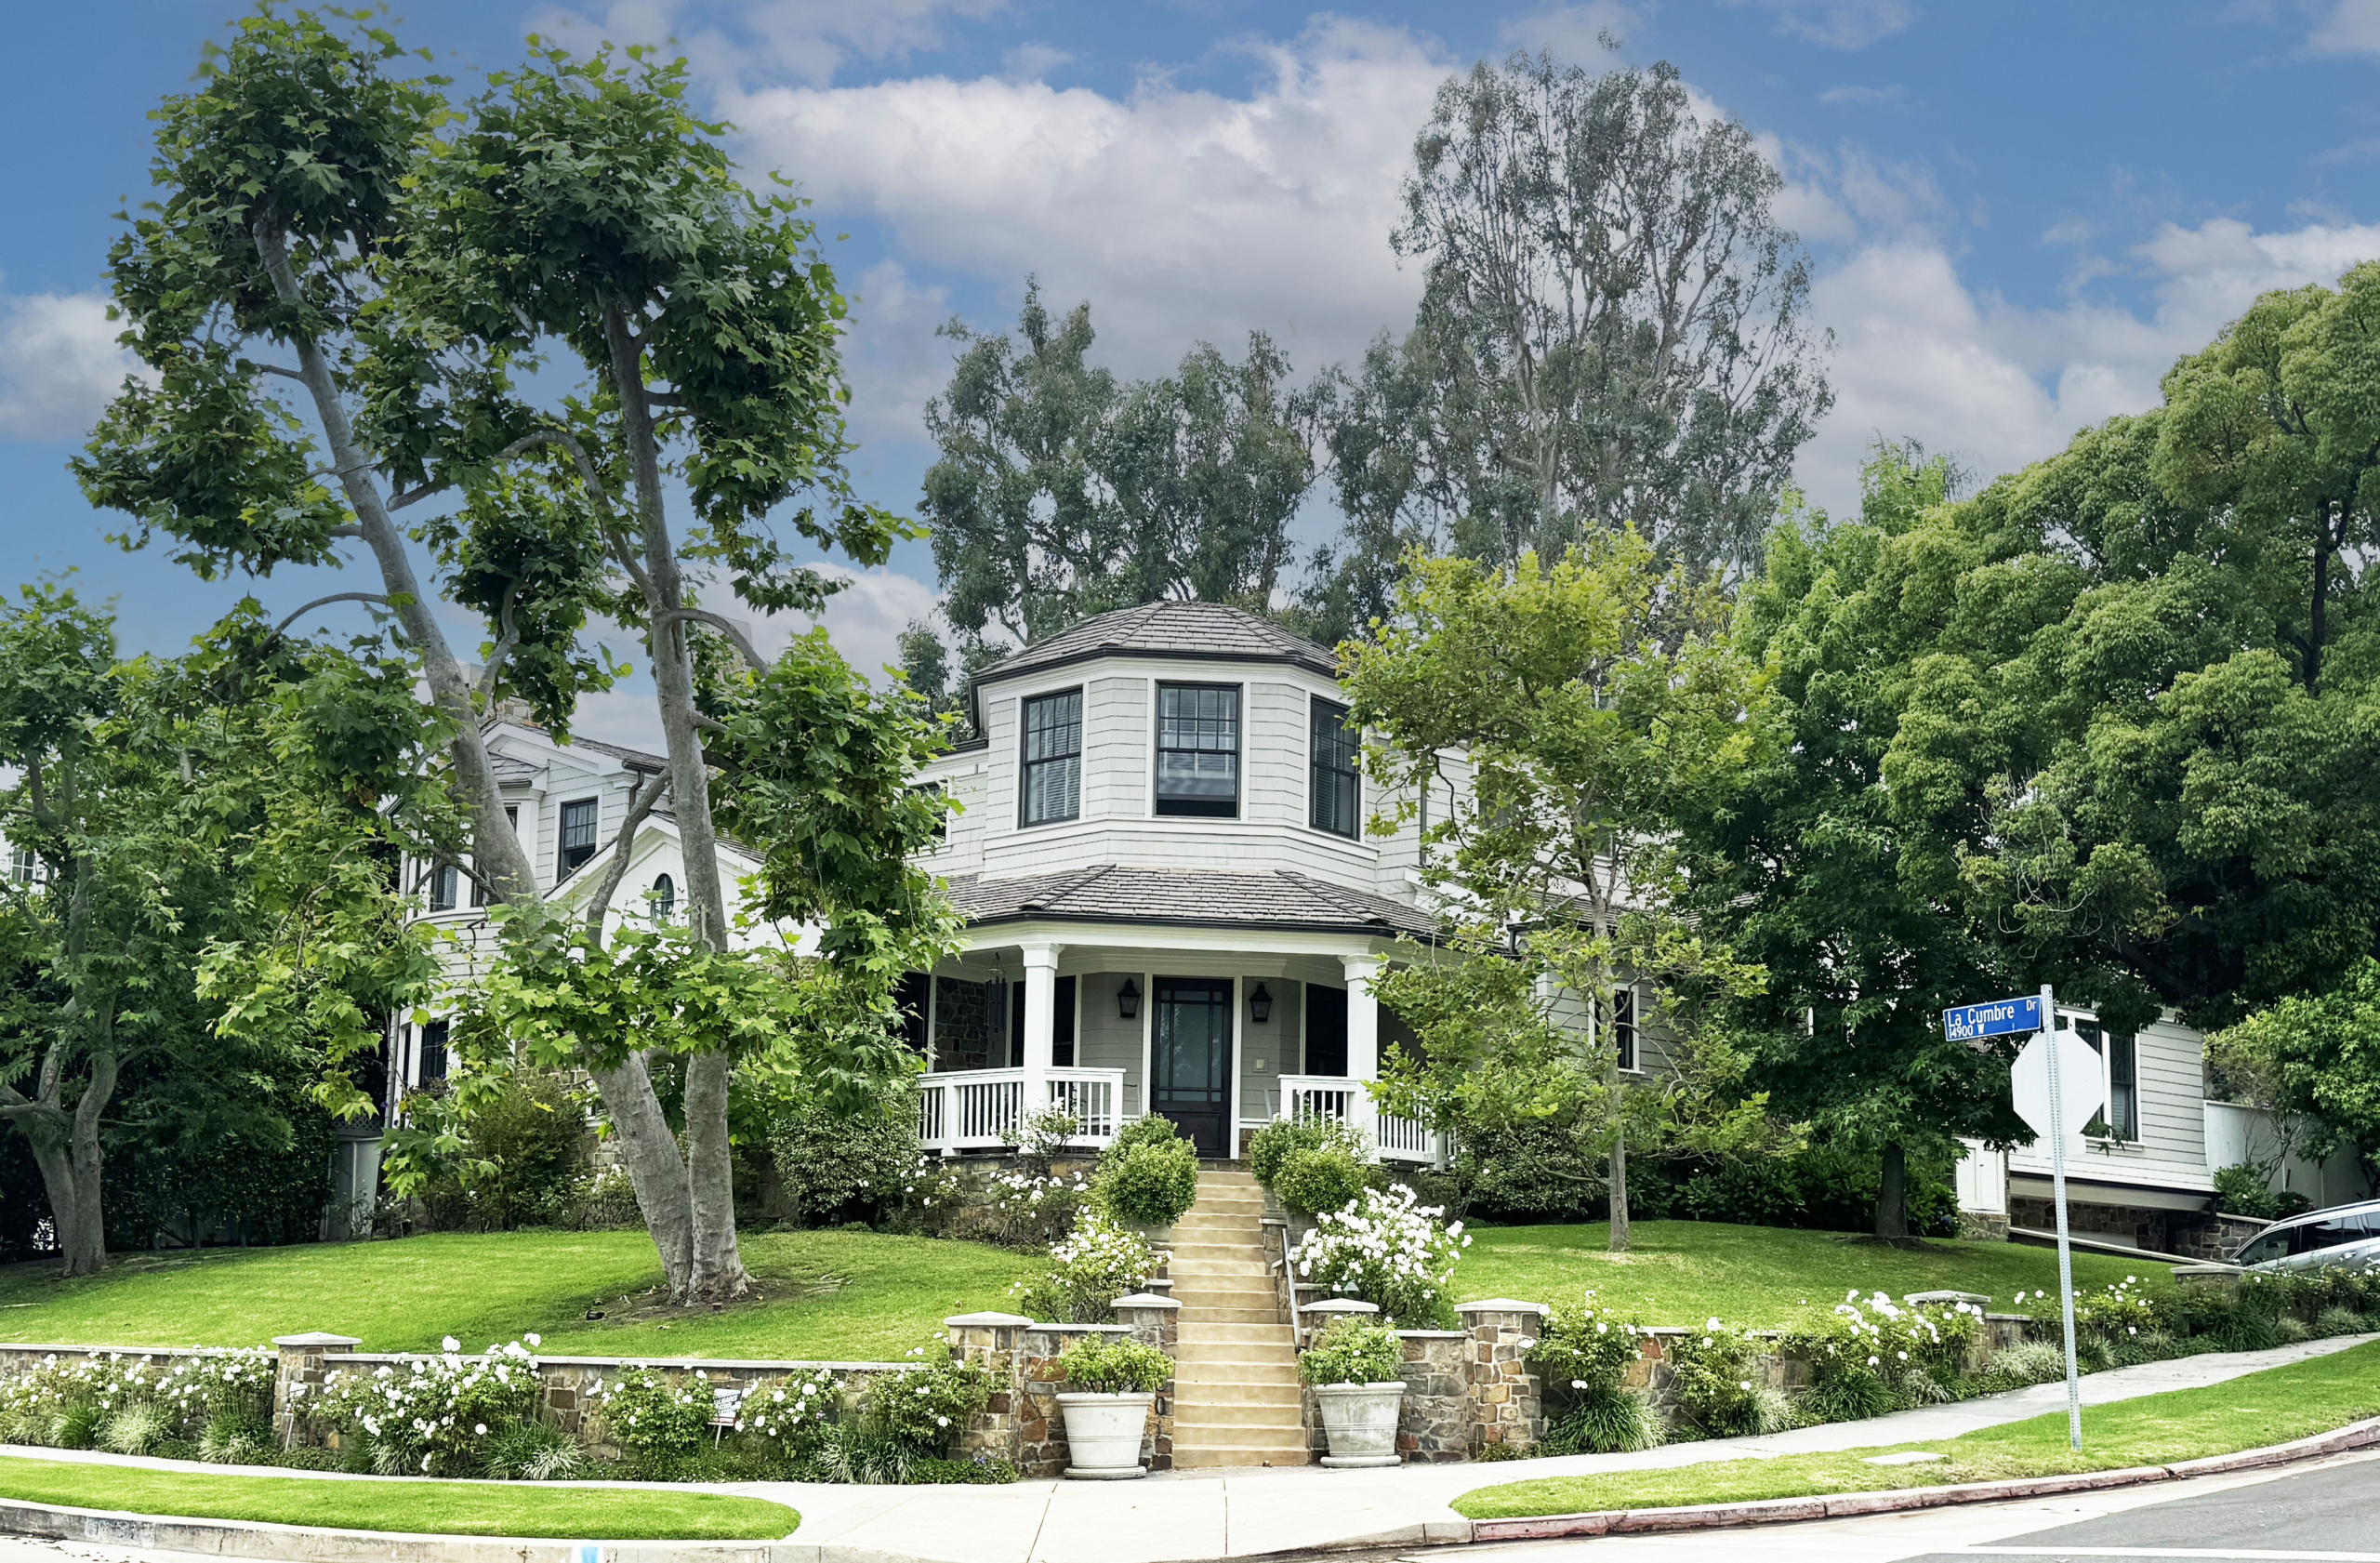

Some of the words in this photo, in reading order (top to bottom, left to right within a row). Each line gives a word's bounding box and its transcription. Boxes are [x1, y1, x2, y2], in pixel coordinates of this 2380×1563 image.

[1948, 1011, 1962, 1027] La
[1968, 1005, 2015, 1025] Cumbre
[2026, 1000, 2037, 1012] Dr
[1949, 1025, 1973, 1039] 14900
[1977, 1023, 1985, 1034] W
